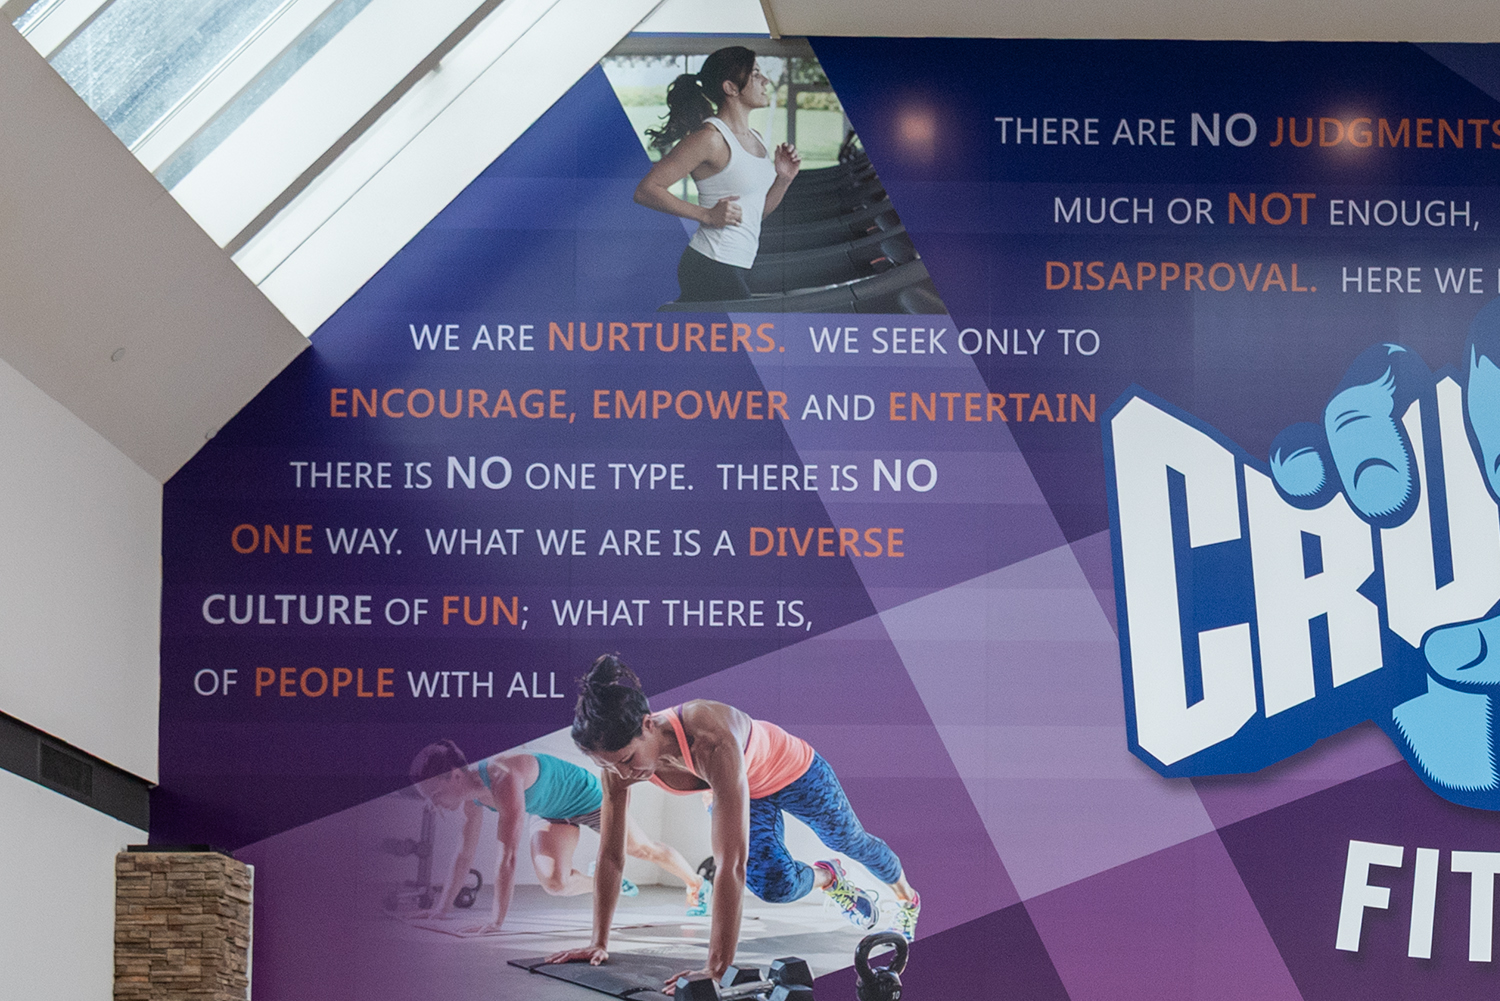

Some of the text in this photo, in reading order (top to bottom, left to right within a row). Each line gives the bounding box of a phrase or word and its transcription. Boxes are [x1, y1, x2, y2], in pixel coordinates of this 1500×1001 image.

[994, 116, 1100, 146] THERE
[1111, 118, 1176, 147] ARE
[1190, 112, 1258, 148] NO
[1054, 196, 1154, 225] MUCH
[1167, 197, 1215, 225] OR
[1228, 191, 1317, 226] NOT
[1329, 199, 1480, 231] ENOUGH,
[1045, 260, 1317, 293] DISAPPROVAL.
[1342, 266, 1422, 294] HERE
[1433, 267, 1484, 294] WE
[409, 321, 1101, 356] WE ARE NURTURERS. WE SEEK ONLY TO
[330, 387, 1096, 424] ENCOURAGE, EMPOWER AND ENTERTAIN
[289, 455, 938, 492] THERE IS NO ONE TYPE. THERE IS NO
[230, 523, 905, 558] ONE WAY. WHAT WE ARE IS A DIVERSE
[202, 593, 813, 632] CULTURE OF FUN; WHAT THERE IS,
[193, 666, 565, 699] OF PEOPLE WITH ALL
